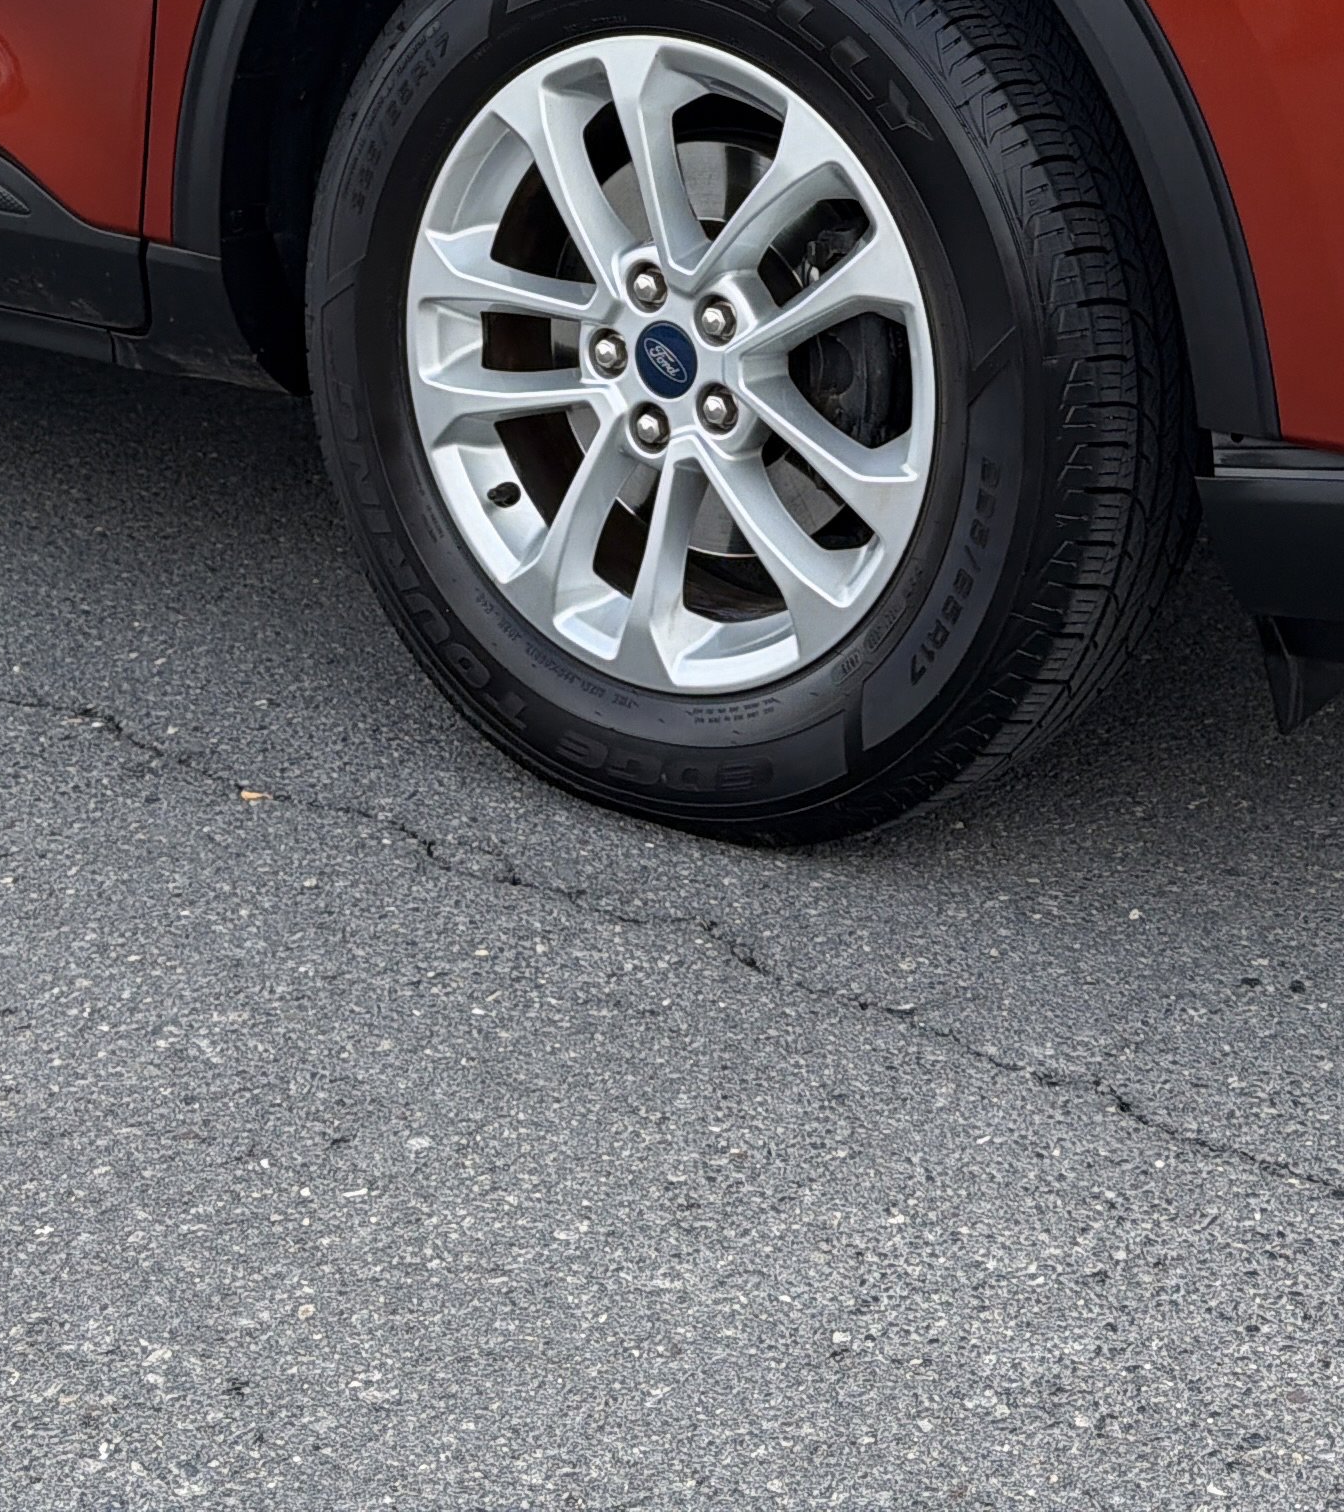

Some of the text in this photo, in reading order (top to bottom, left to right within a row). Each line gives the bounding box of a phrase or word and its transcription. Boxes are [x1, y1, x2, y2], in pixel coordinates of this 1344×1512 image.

[649, 345, 681, 377] Ford
[331, 378, 530, 732] TOURING
[555, 729, 774, 792] EDGE
